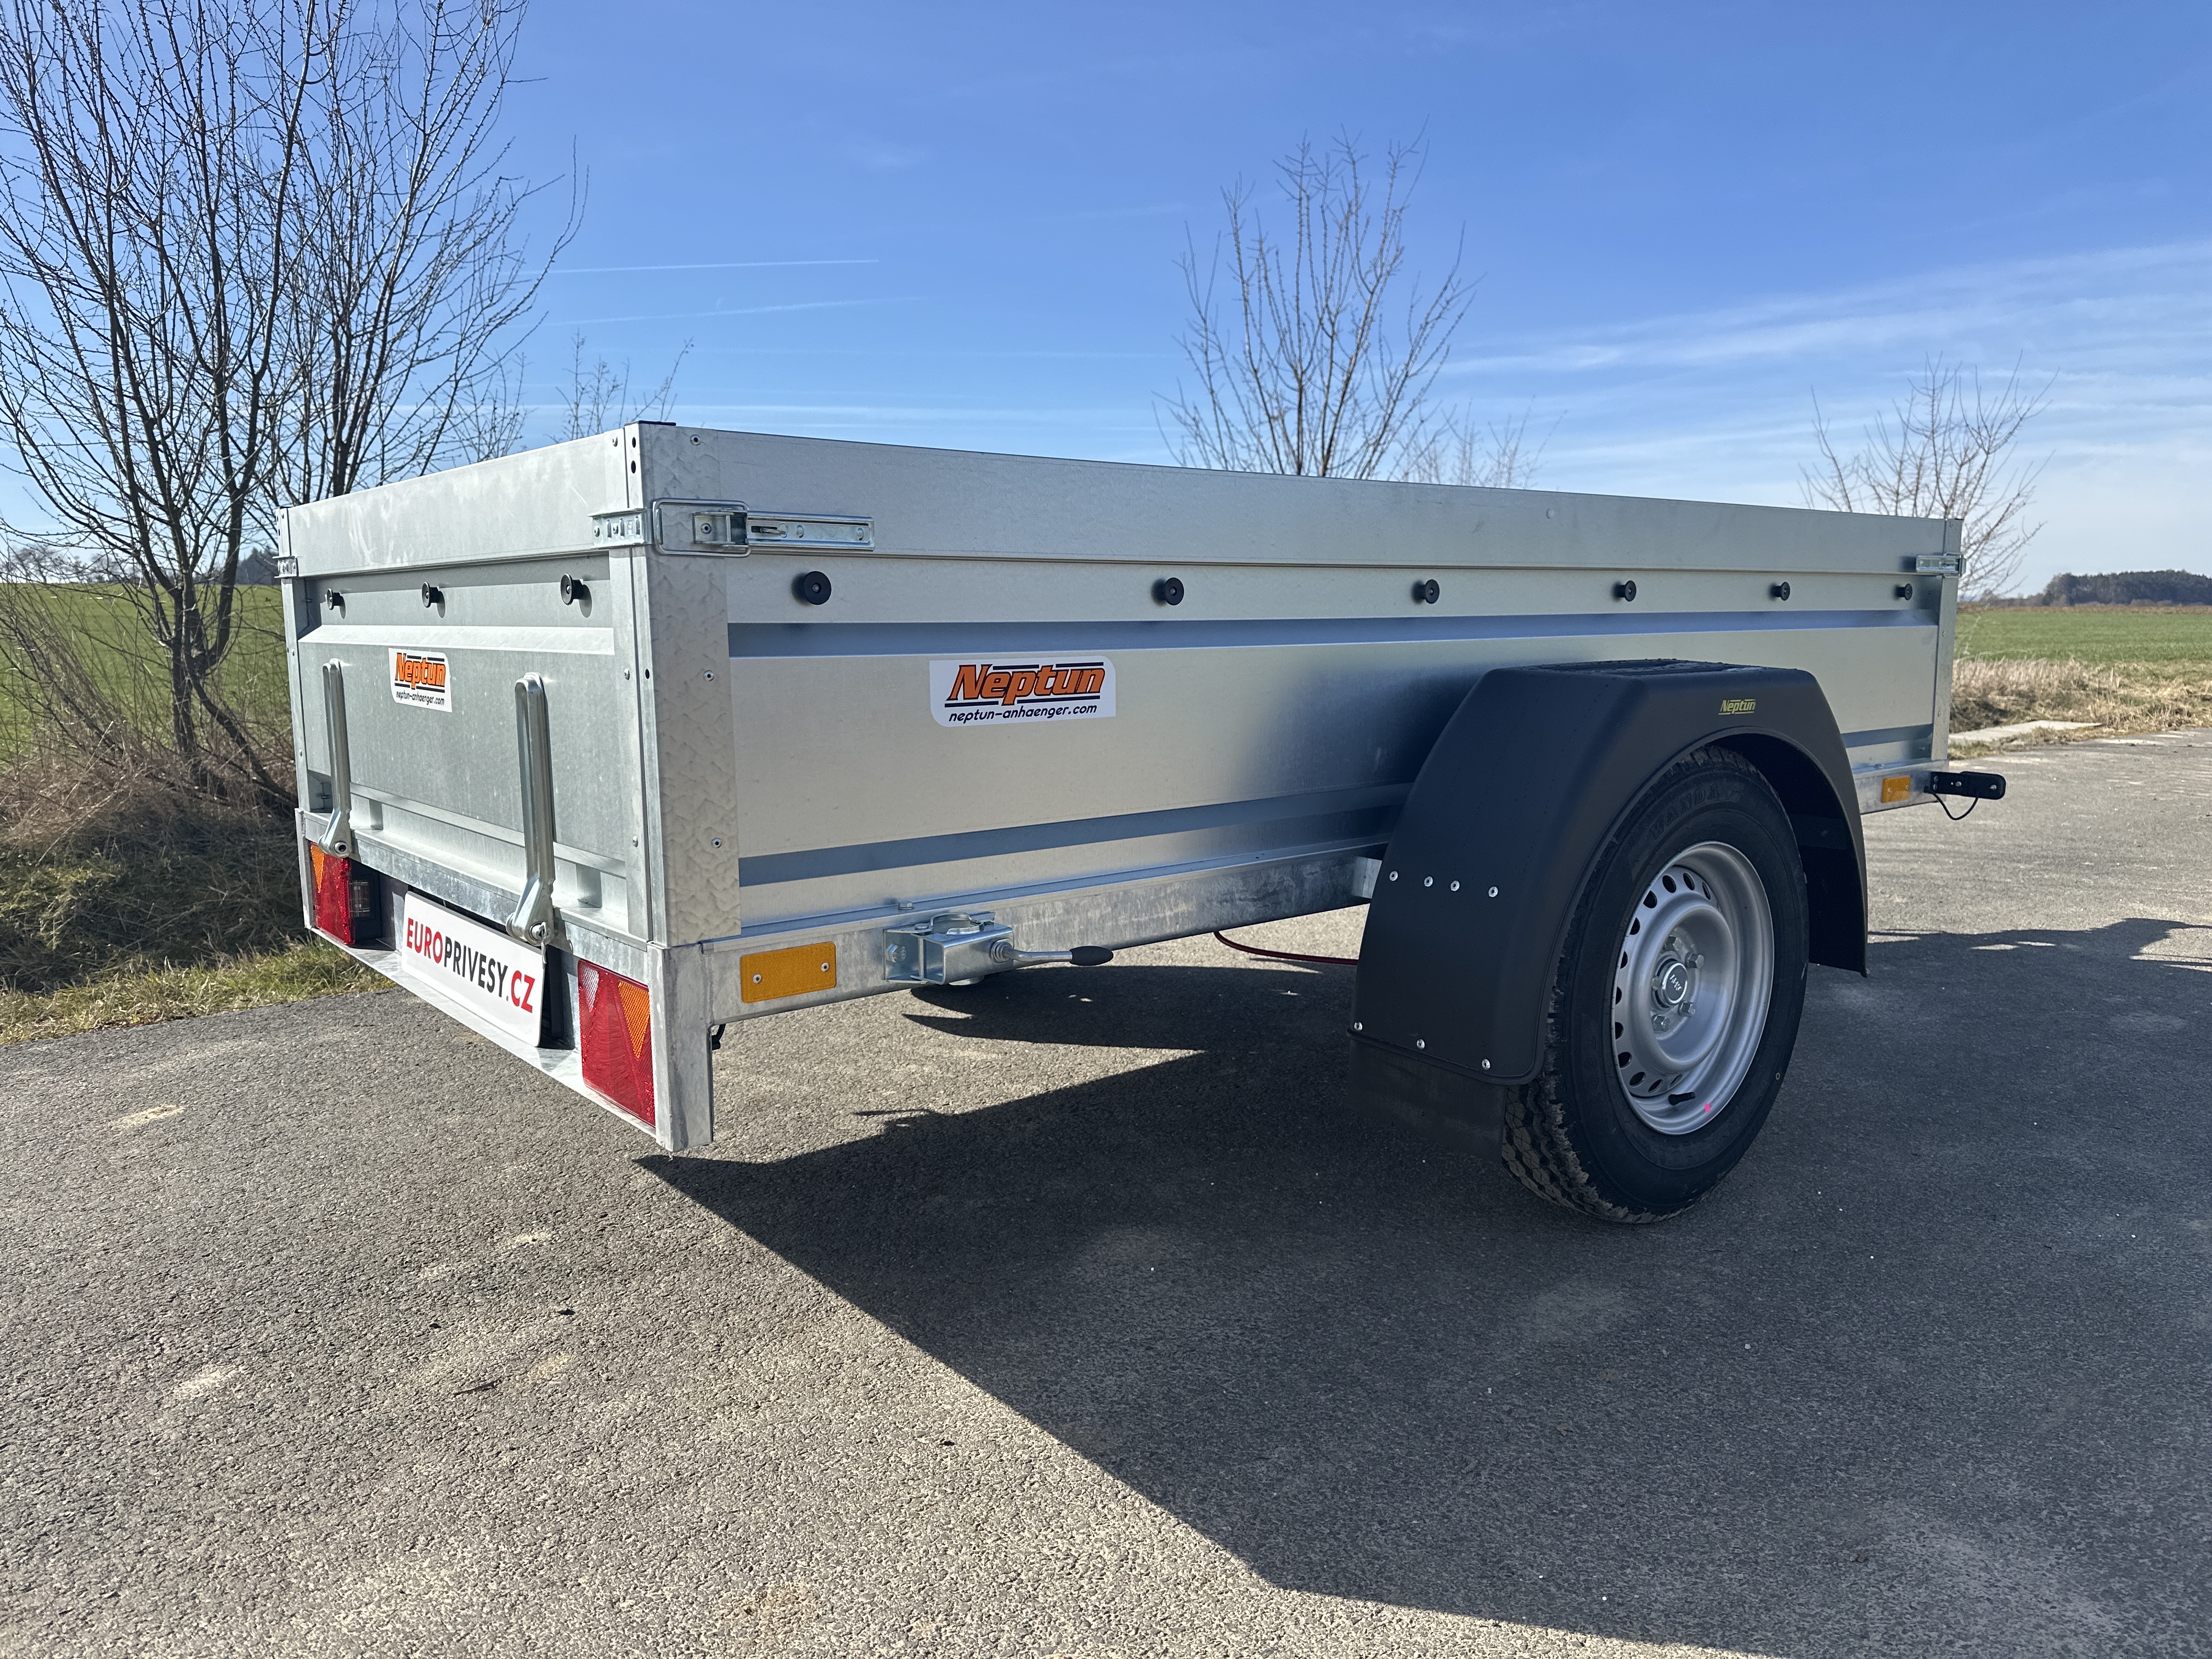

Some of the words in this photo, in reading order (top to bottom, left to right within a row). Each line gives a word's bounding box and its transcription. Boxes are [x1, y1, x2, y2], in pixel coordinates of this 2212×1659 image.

[394, 652, 446, 690] Neptun
[945, 663, 1106, 707] Neptun
[948, 703, 1098, 725] neptun-anhaenger.com
[1719, 699, 1756, 714] Neptun
[1649, 785, 1720, 840] WANDA
[406, 917, 536, 1014] EUROPRIVESY.CZ
